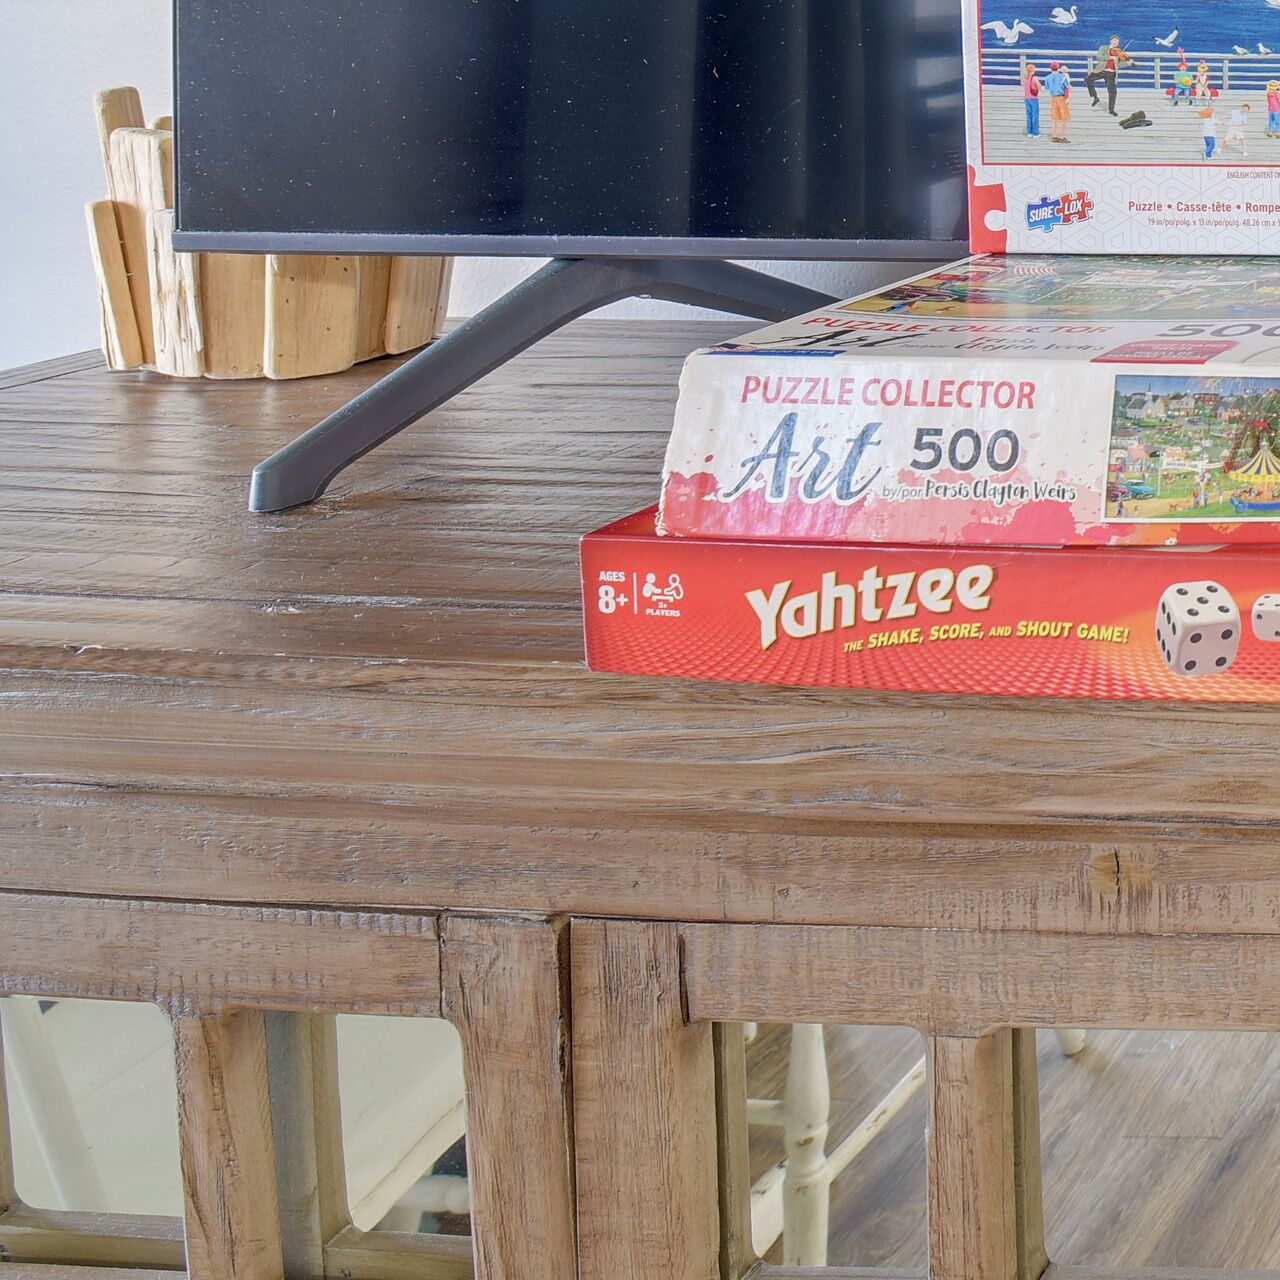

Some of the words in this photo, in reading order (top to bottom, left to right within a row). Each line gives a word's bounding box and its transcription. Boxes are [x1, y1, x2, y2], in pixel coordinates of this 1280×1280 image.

[1227, 171, 1249, 179] ENGLISH
[1250, 171, 1273, 180] CONTENT
[1029, 206, 1054, 223] SURE
[1063, 199, 1083, 215] LOX
[1128, 201, 1163, 212] Puzzle
[1176, 201, 1232, 213] Casse-tête
[801, 318, 930, 332] PUZZLE
[929, 325, 1113, 334] COLLECTOR
[750, 330, 929, 347] Art
[741, 376, 855, 405] PUZZLE
[862, 378, 1036, 409] COLLECTOR
[722, 412, 882, 501] Art
[910, 427, 1019, 472] 500
[925, 481, 969, 499] Persis
[973, 481, 1029, 506] Clayton
[1034, 483, 1076, 501] Weirs
[599, 571, 625, 582] AGES
[598, 585, 628, 614] 8+
[744, 563, 995, 651] Yahtzee
[646, 608, 681, 617] PLAYERS
[843, 641, 863, 653] THE
[867, 628, 925, 649] SHAKE,
[928, 623, 985, 642] SCORE,
[988, 625, 1012, 638] AND
[1016, 620, 1073, 638] SHOUT
[1076, 623, 1129, 644] GAME!
